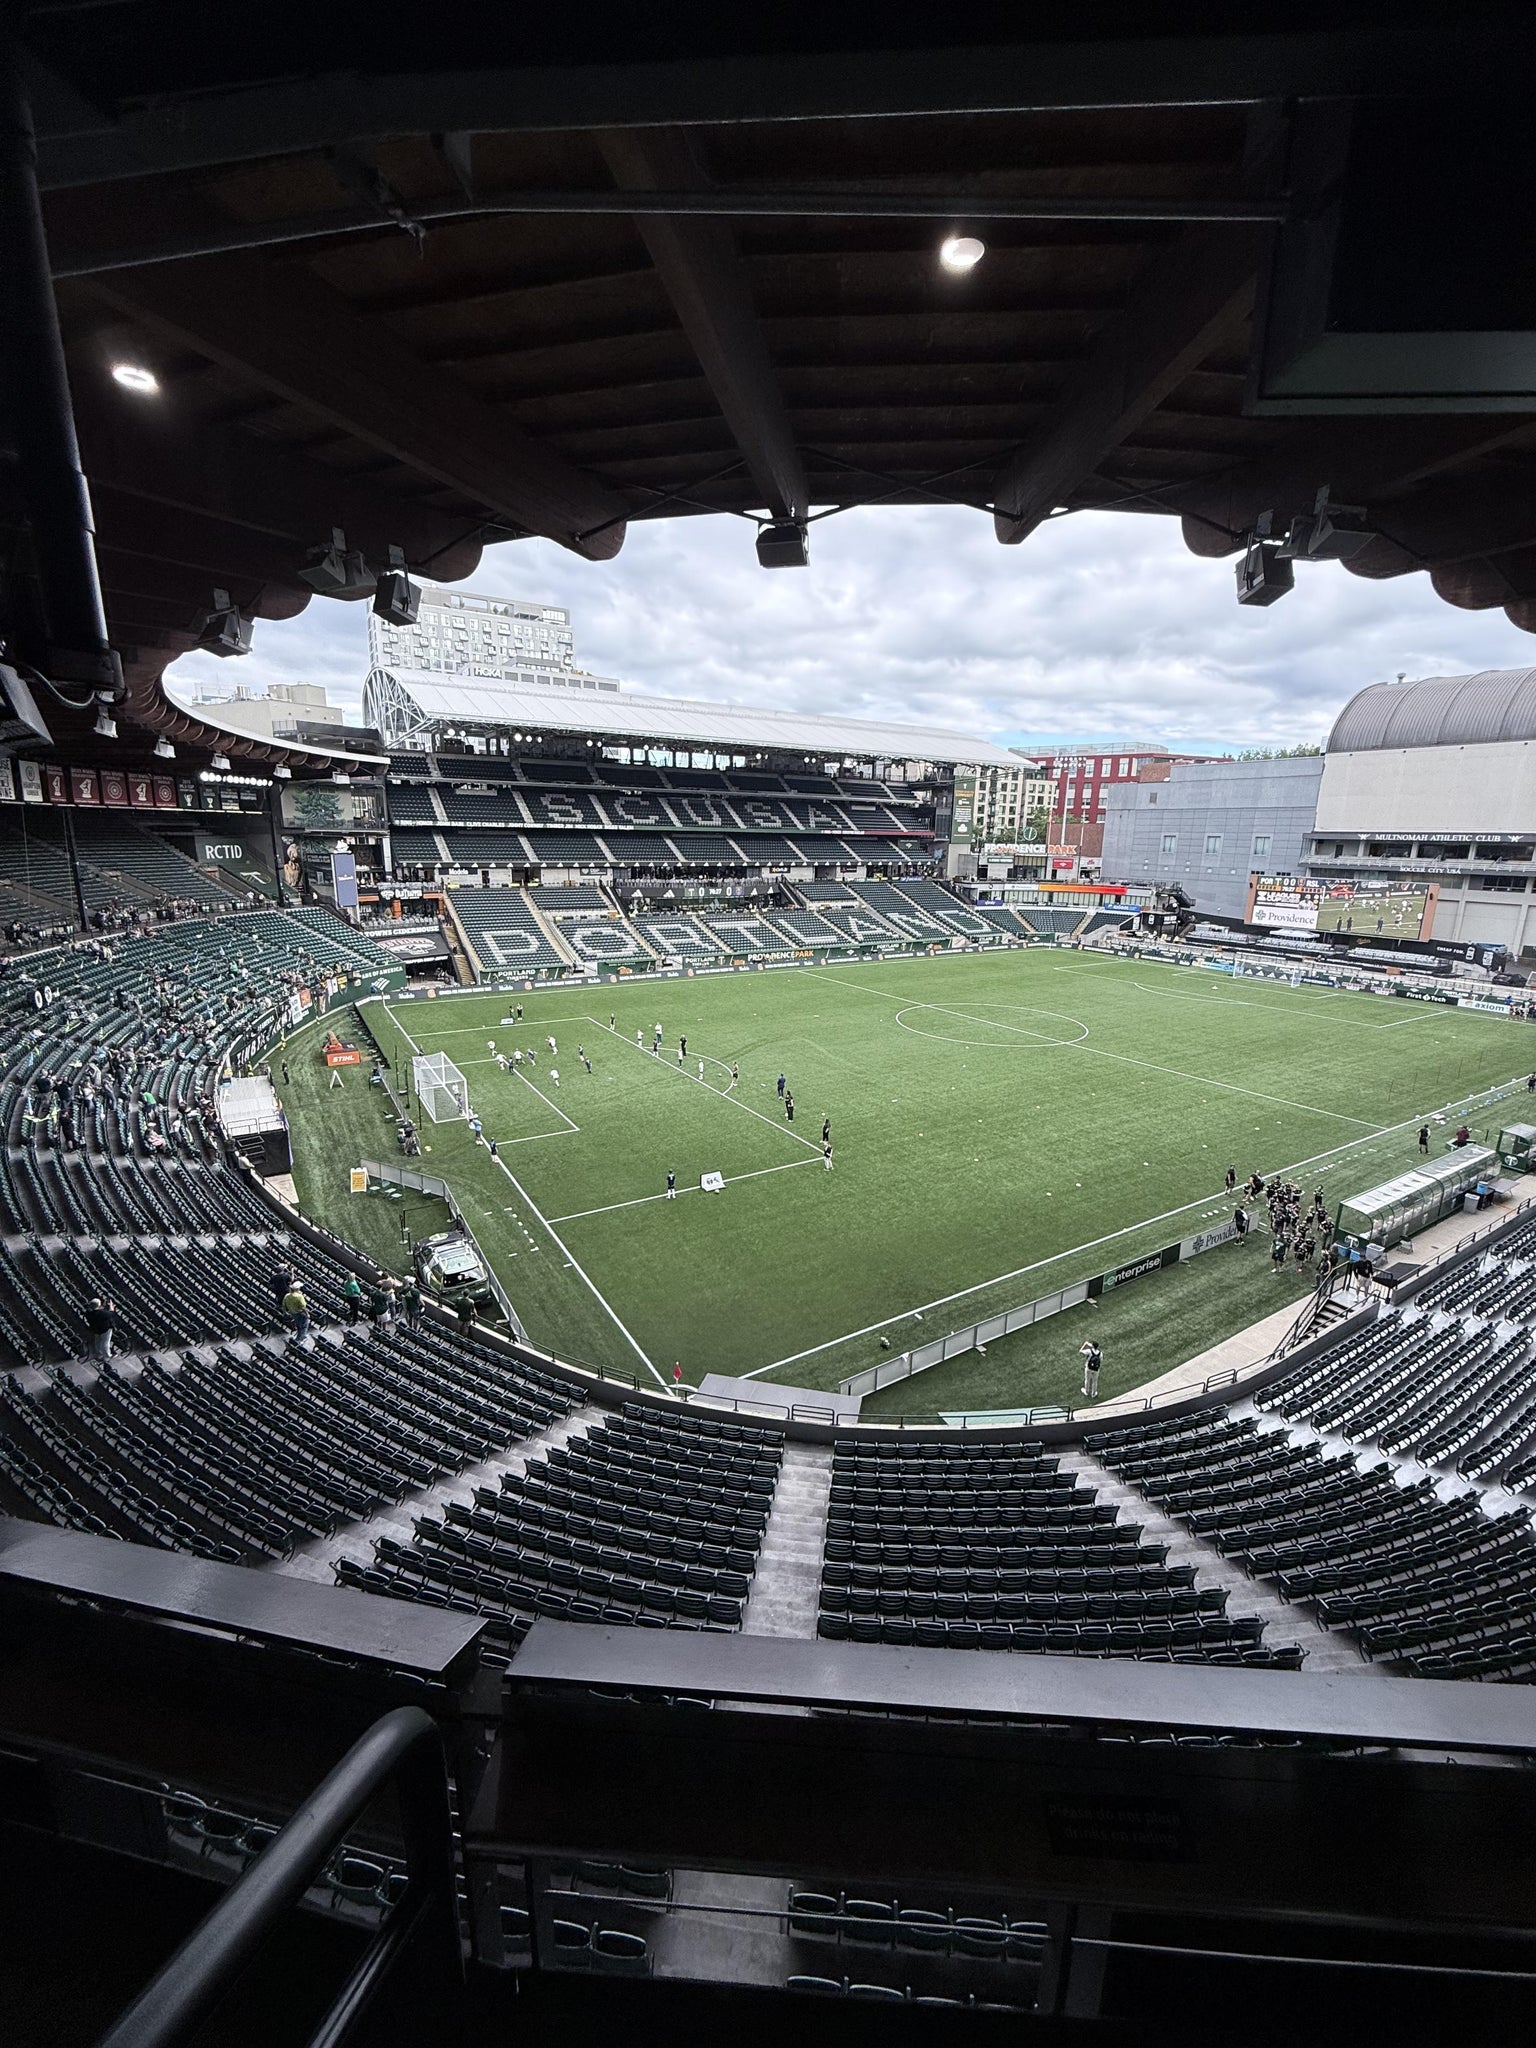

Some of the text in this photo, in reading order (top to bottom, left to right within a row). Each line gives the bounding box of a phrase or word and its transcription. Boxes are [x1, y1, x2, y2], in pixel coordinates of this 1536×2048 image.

[1375, 833, 1429, 842] MULTNOMAH
[1430, 834, 1472, 842] ATHLETIC
[205, 844, 243, 859] RCTID
[984, 843, 1078, 855] PROVIDENCE PARK
[1260, 877, 1274, 885] POR
[1268, 912, 1315, 924] Providence
[364, 926, 440, 937] TOWNS CIDERHOUSE
[481, 910, 992, 965] PORTLAND
[685, 956, 715, 964] PORTLAND
[379, 966, 403, 975] AMERICA
[498, 968, 536, 977] PORTLAND
[1405, 991, 1422, 1000] First
[1430, 995, 1446, 1003] Tech
[1474, 1001, 1505, 1012] axiom
[332, 1054, 355, 1063] STIHL
[1103, 1257, 1161, 1286] enterprise
